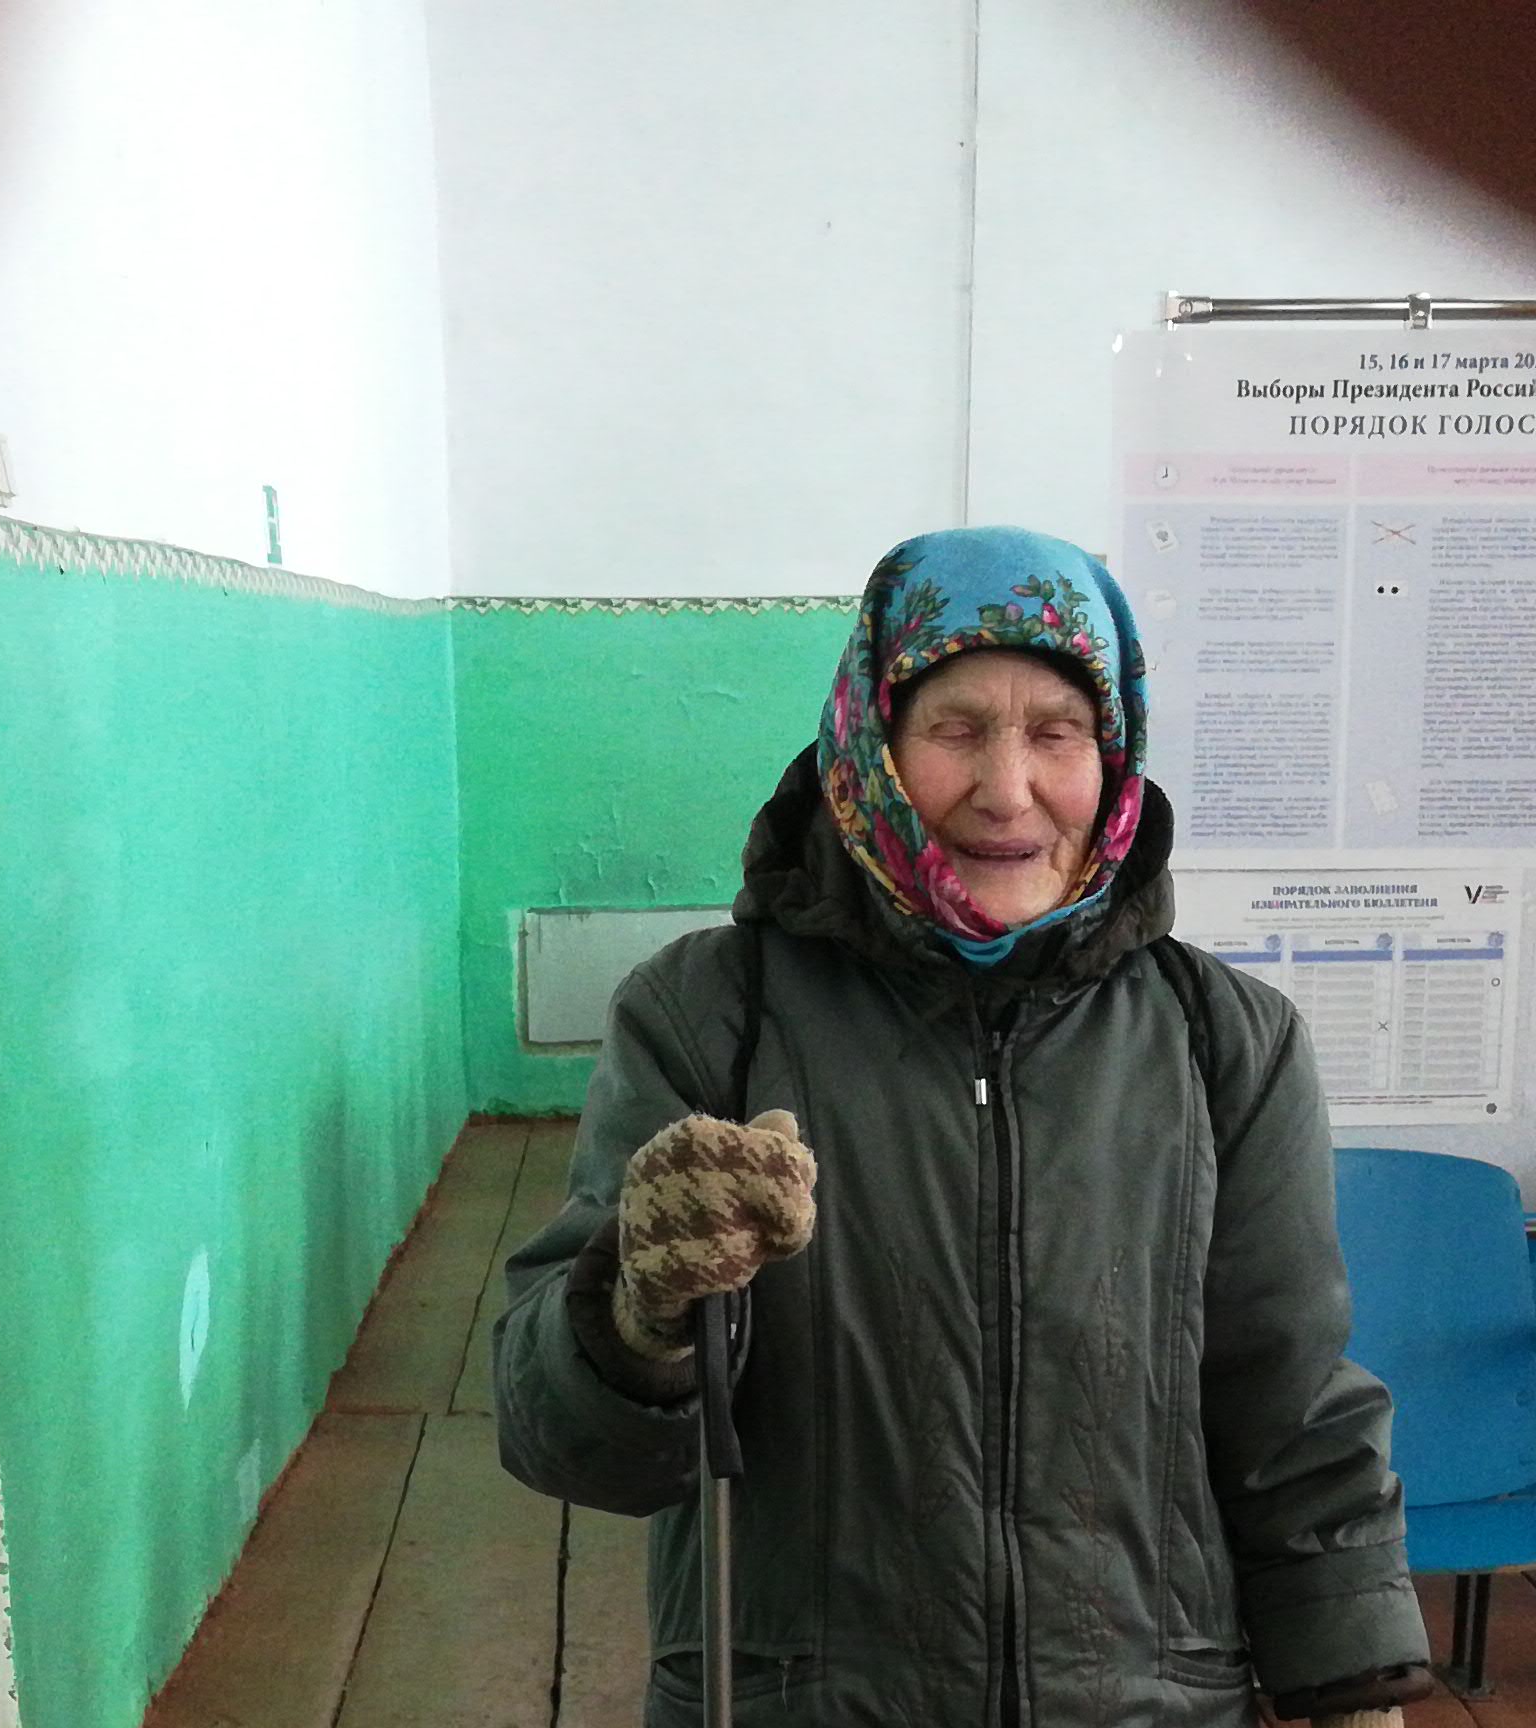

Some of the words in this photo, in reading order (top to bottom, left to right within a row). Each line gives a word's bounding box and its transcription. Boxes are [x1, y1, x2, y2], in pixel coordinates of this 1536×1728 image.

[1359, 354, 1383, 371] 15,
[1390, 354, 1409, 370] 16
[1413, 358, 1425, 370] и
[1431, 354, 1451, 370] 17
[1455, 357, 1509, 374] марта
[1236, 379, 1325, 404] Выборы
[1331, 378, 1460, 404] Президента
[1288, 414, 1427, 439] ПОРЯДОК
